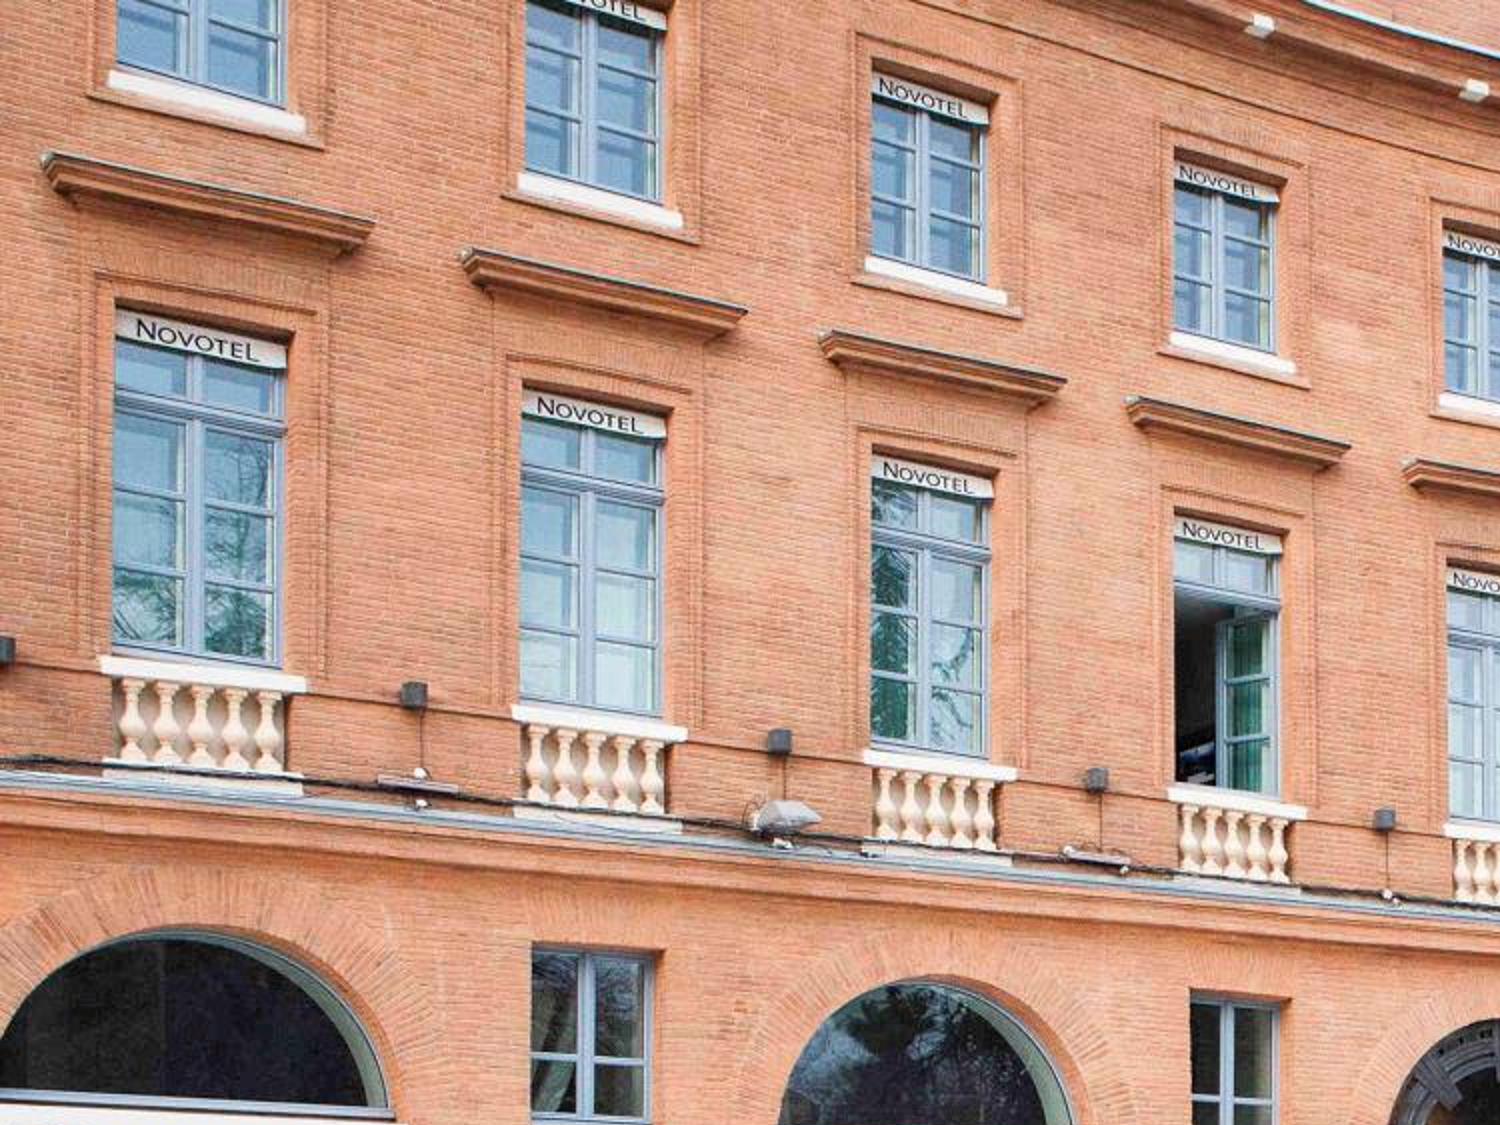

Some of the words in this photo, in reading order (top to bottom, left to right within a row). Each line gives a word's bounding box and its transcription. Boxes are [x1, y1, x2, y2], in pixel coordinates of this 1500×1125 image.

[581, 0, 646, 21] OTEL
[879, 77, 969, 119] NOVOTEL
[1180, 165, 1260, 198] NOVOTEL
[136, 317, 261, 363] NOVOTEL
[537, 396, 644, 435] NOVOTEL
[883, 461, 976, 495] NOVOTEL
[1183, 521, 1265, 551] NOVOTEL
